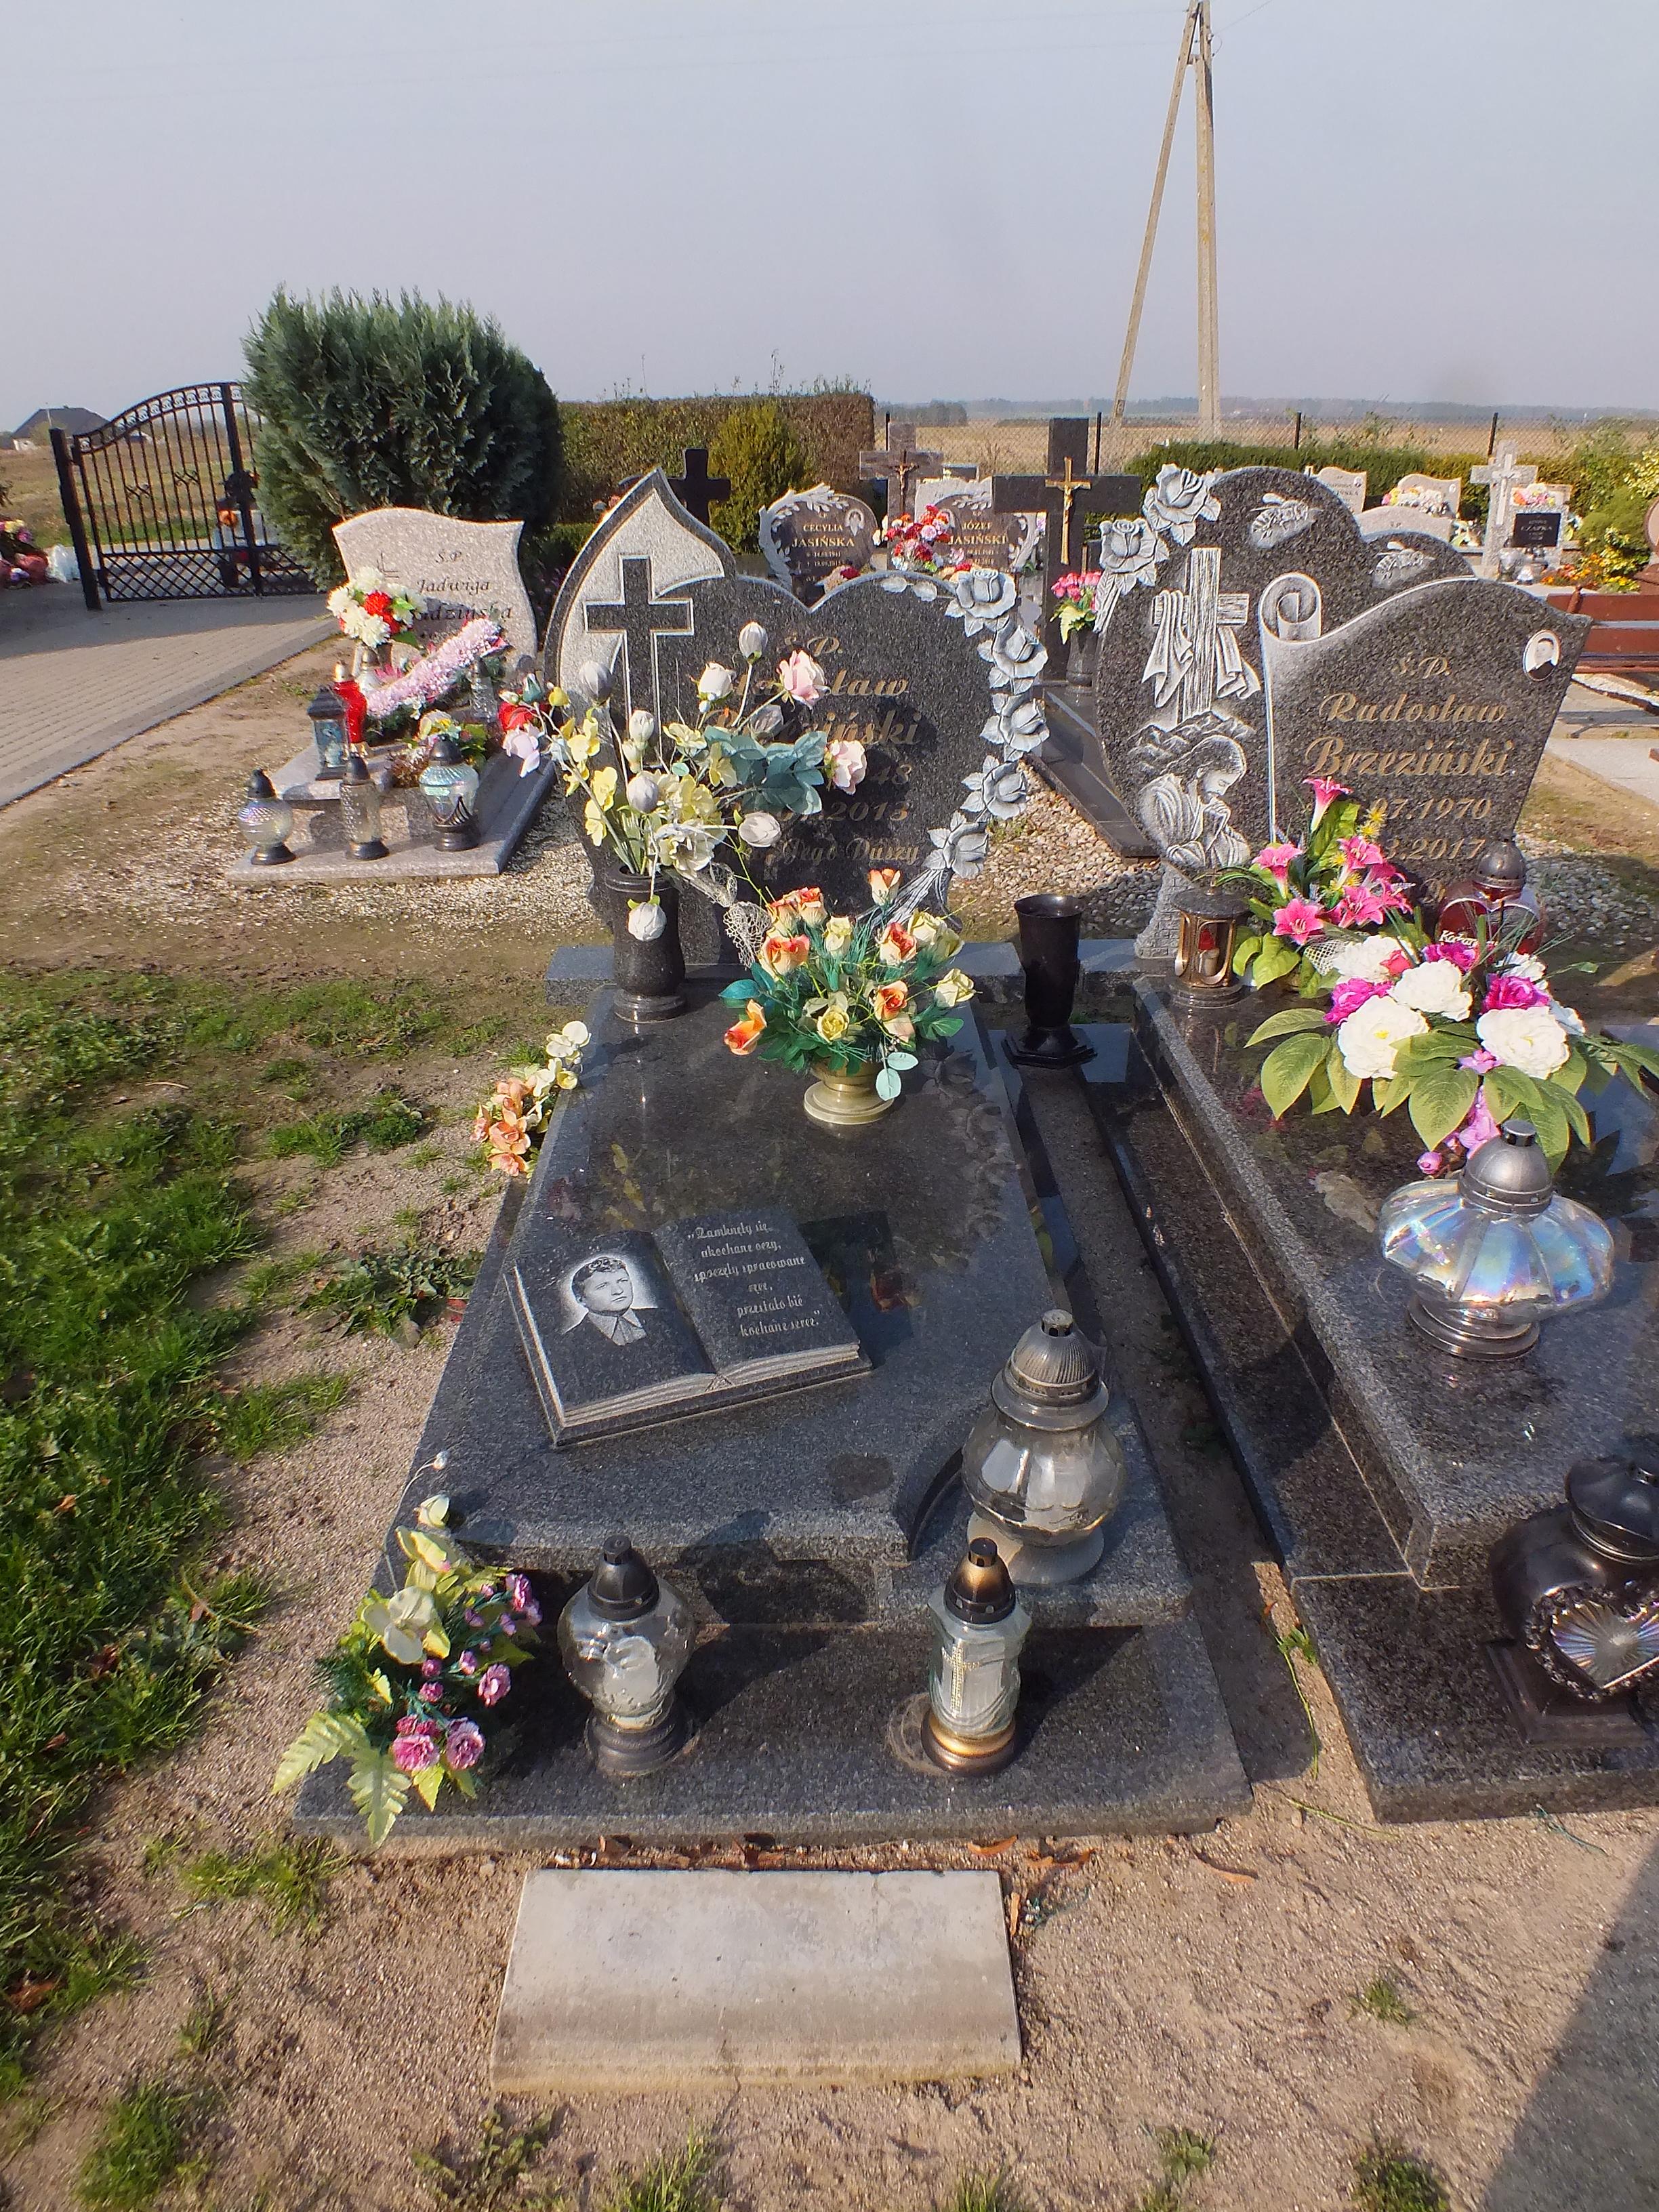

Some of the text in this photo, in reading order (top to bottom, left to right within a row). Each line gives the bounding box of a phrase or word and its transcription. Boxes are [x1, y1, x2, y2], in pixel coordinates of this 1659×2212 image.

[803, 524, 844, 532] CECYLIA
[962, 519, 993, 530] JÓZEF
[792, 535, 855, 548] JASIŃSKA
[948, 533, 1007, 545] JASIŃSKI
[417, 577, 490, 596] Jadwiga
[1319, 692, 1509, 723] Radosław
[1305, 735, 1515, 777] Brzeziński
[740, 1322, 787, 1337] kochane
